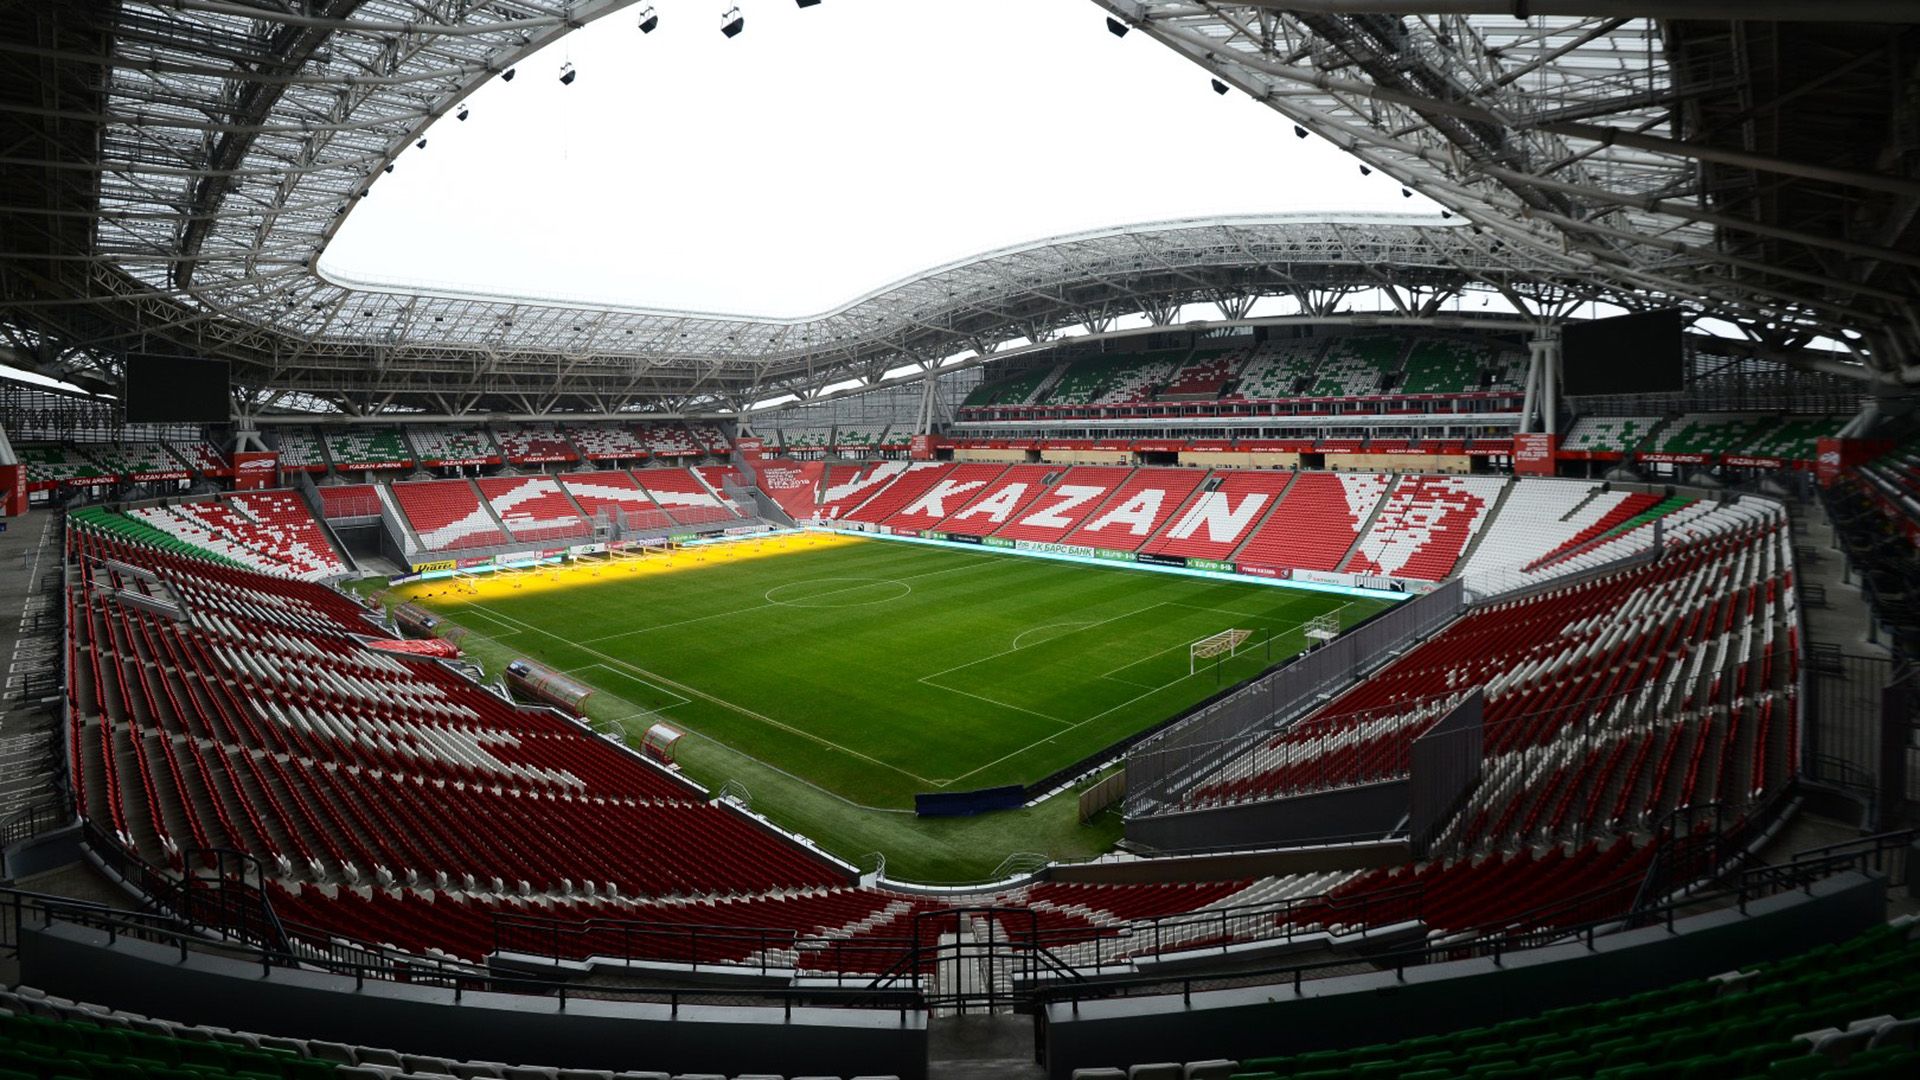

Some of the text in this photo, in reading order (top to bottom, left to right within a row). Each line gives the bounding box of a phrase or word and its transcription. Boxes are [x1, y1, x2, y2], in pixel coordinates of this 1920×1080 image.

[1641, 454, 1703, 462] KAZAN ARENA
[1727, 457, 1780, 467] KAZAN ARENA
[69, 476, 114, 486] KAZAN ARENA
[134, 472, 188, 481] KAZAN ARENA
[904, 478, 1269, 542] KAZAN
